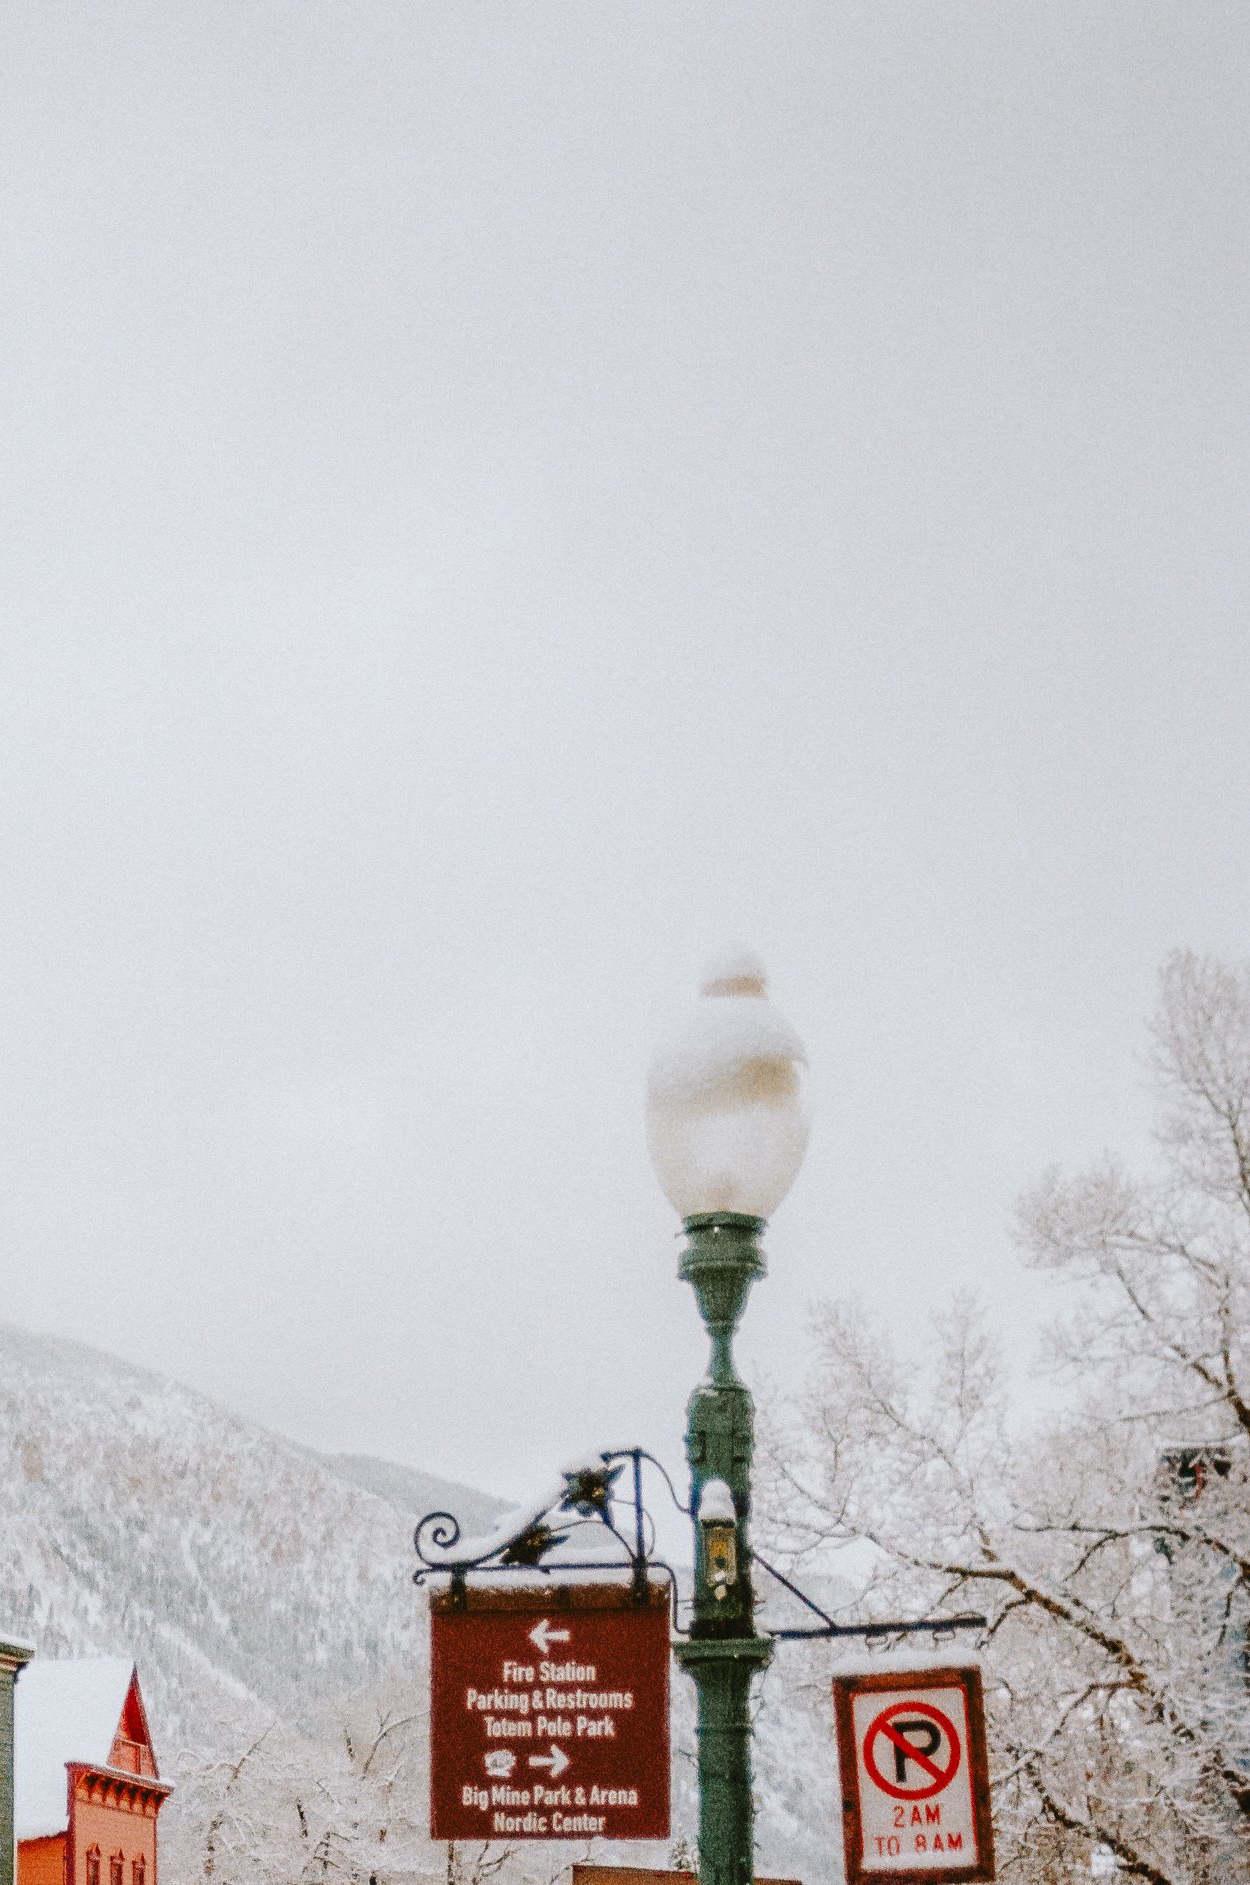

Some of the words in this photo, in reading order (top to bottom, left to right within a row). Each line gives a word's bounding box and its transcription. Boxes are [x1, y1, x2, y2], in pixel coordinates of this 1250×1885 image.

[503, 1662, 534, 1681] Fire
[540, 1662, 596, 1681] Station
[467, 1688, 529, 1713] Parking
[532, 1690, 544, 1709] &
[546, 1689, 633, 1709] Restrooms
[484, 1717, 531, 1737] Totem
[537, 1717, 571, 1737] Pole
[577, 1716, 614, 1737] Park
[892, 1719, 941, 1783] P
[463, 1787, 489, 1810] Big
[492, 1787, 530, 1806] Mine
[534, 1787, 570, 1805] Park
[575, 1787, 586, 1805] &
[589, 1787, 637, 1806] Arena
[493, 1812, 547, 1832] Nordic
[552, 1812, 605, 1832] Center
[875, 1836, 900, 1856] TO
